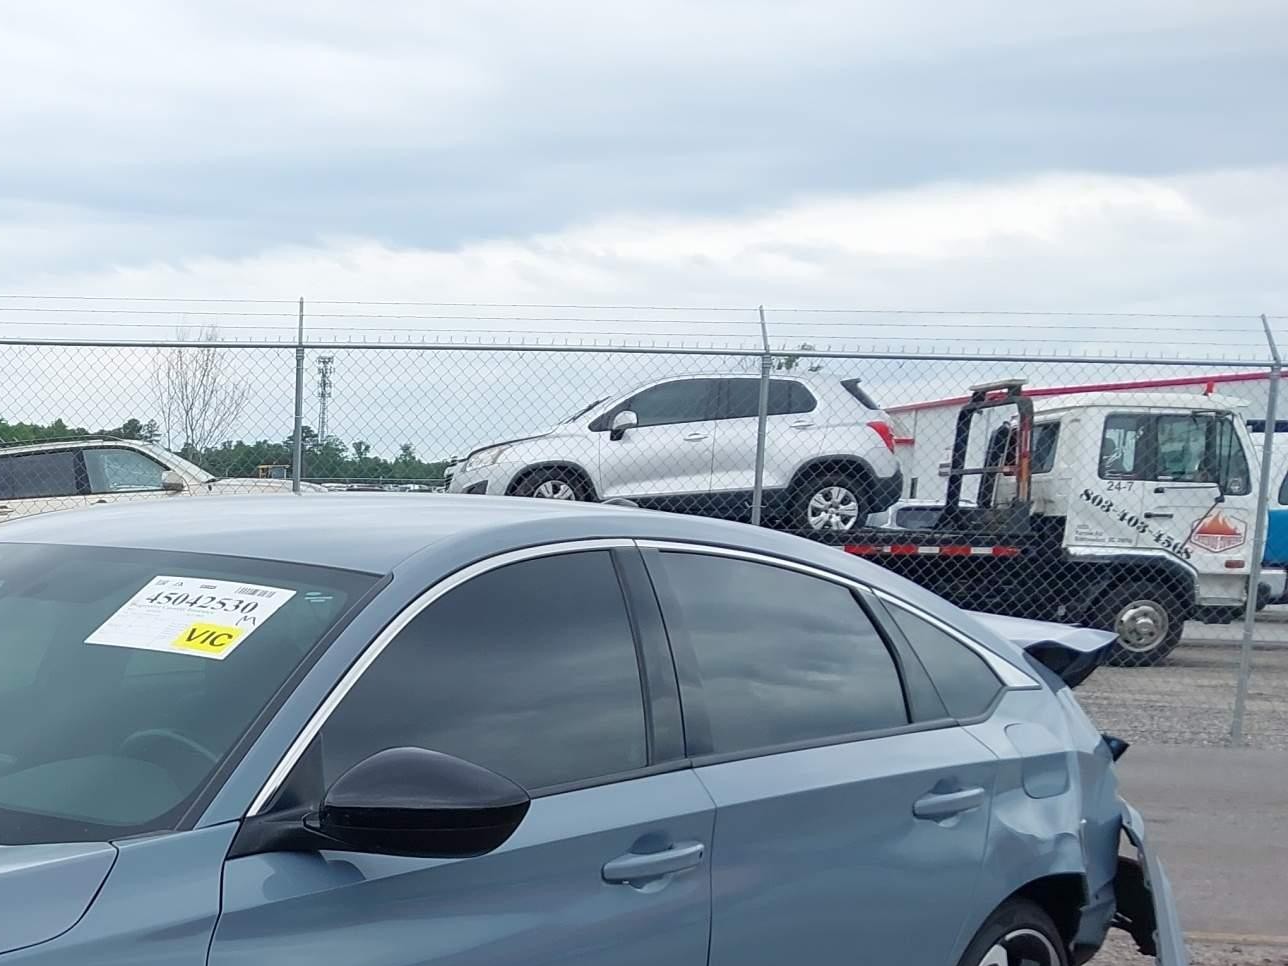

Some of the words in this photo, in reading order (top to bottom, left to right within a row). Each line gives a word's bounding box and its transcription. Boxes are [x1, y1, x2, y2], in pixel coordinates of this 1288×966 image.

[1106, 480, 1134, 491] 24-7
[145, 591, 259, 614] 45042530
[185, 627, 234, 648] VIC
